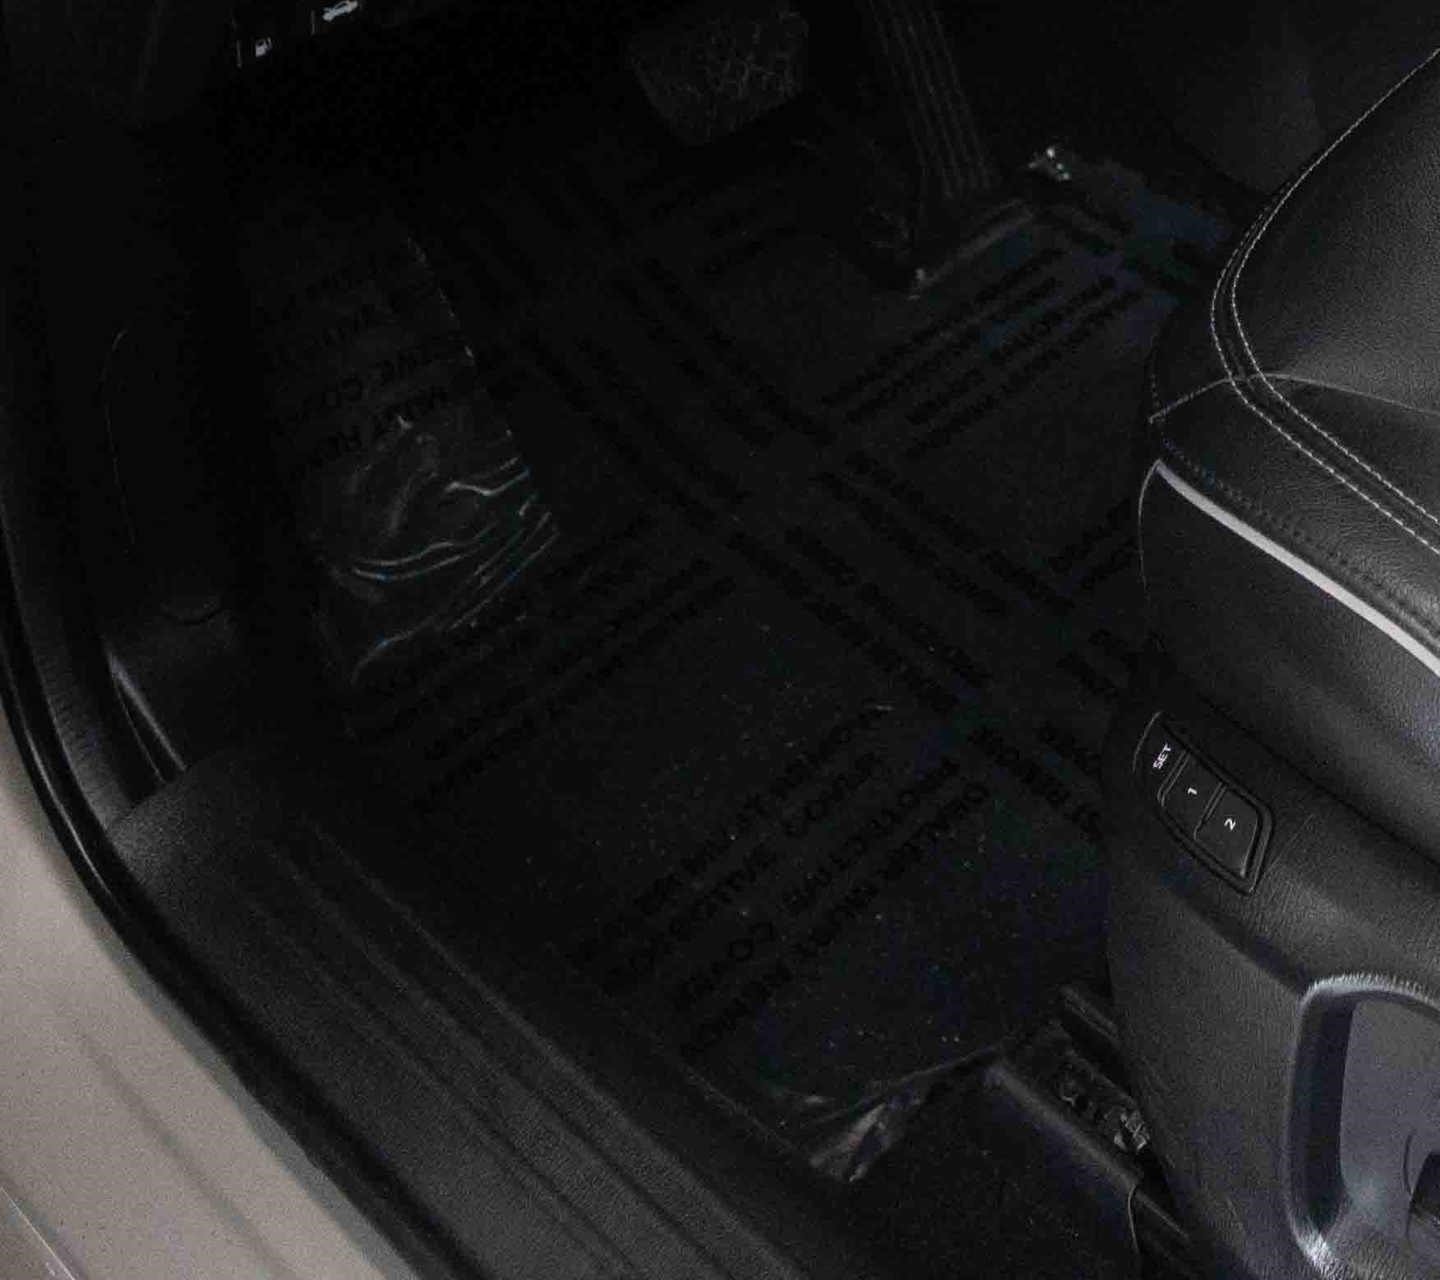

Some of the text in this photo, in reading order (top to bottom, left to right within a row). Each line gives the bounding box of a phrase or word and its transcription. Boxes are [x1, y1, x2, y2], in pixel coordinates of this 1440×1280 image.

[1152, 743, 1172, 770] SET
[1187, 786, 1198, 796] 1
[1224, 817, 1237, 832] 2
